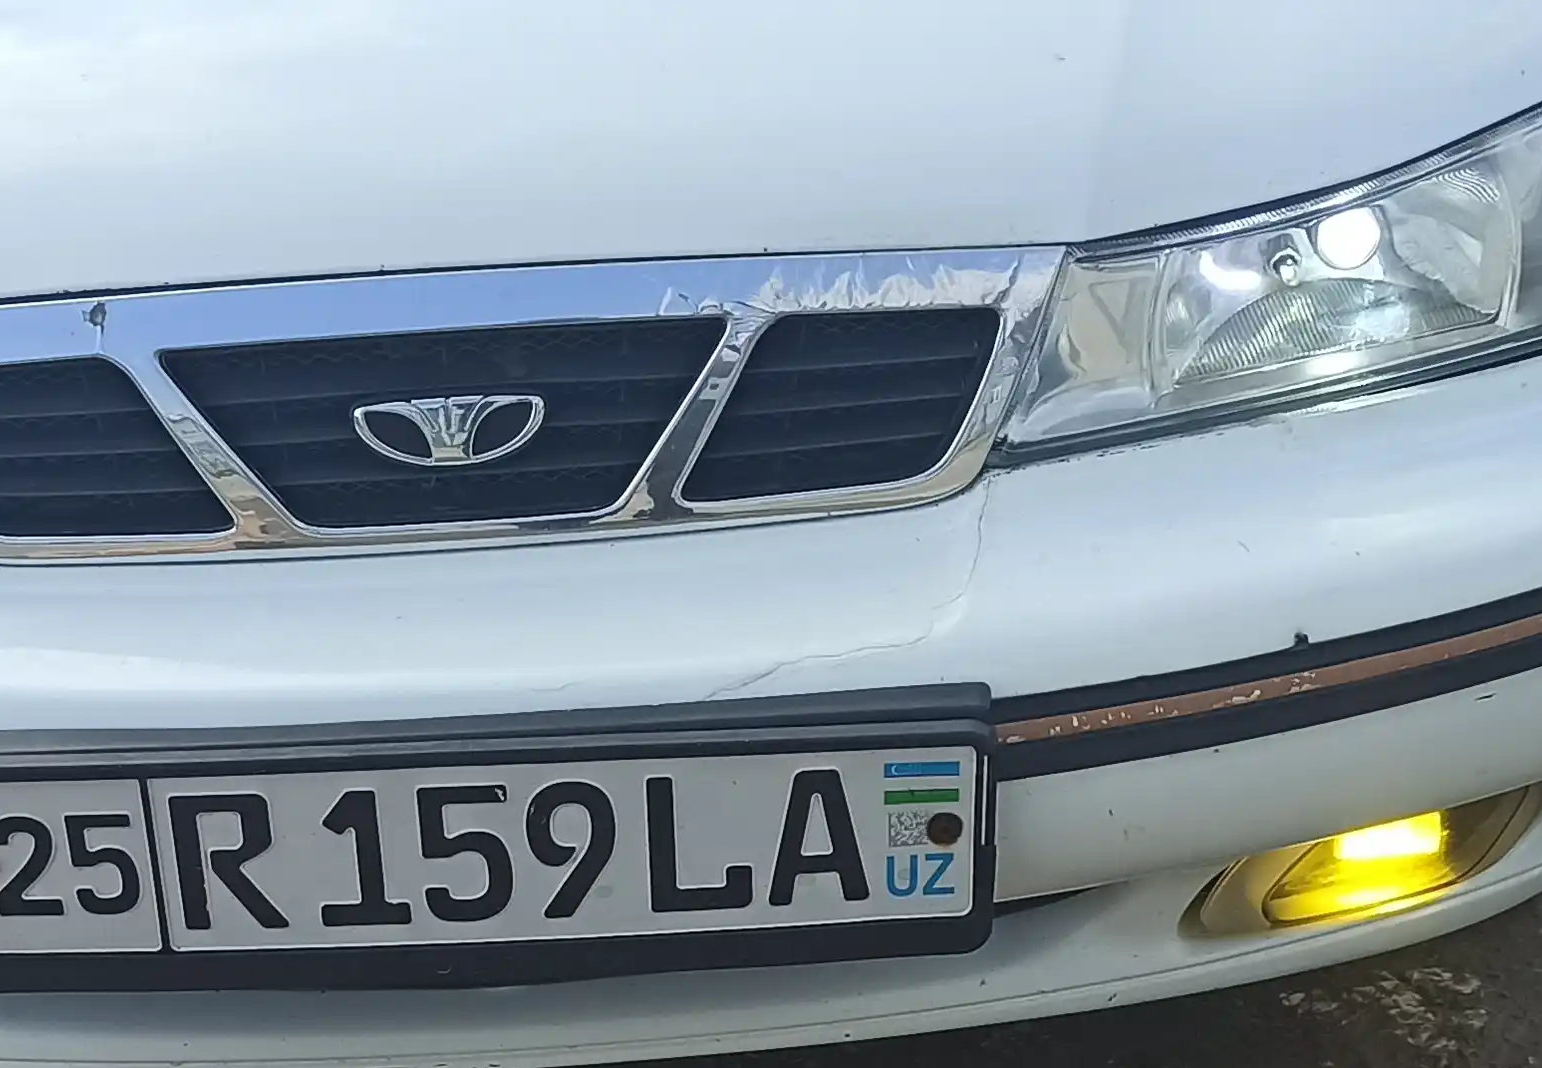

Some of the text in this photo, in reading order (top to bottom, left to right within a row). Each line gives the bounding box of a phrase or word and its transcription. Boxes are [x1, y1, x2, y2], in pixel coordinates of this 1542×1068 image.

[321, 780, 616, 927] 159
[645, 768, 870, 913] LA
[886, 852, 955, 897] UZ
